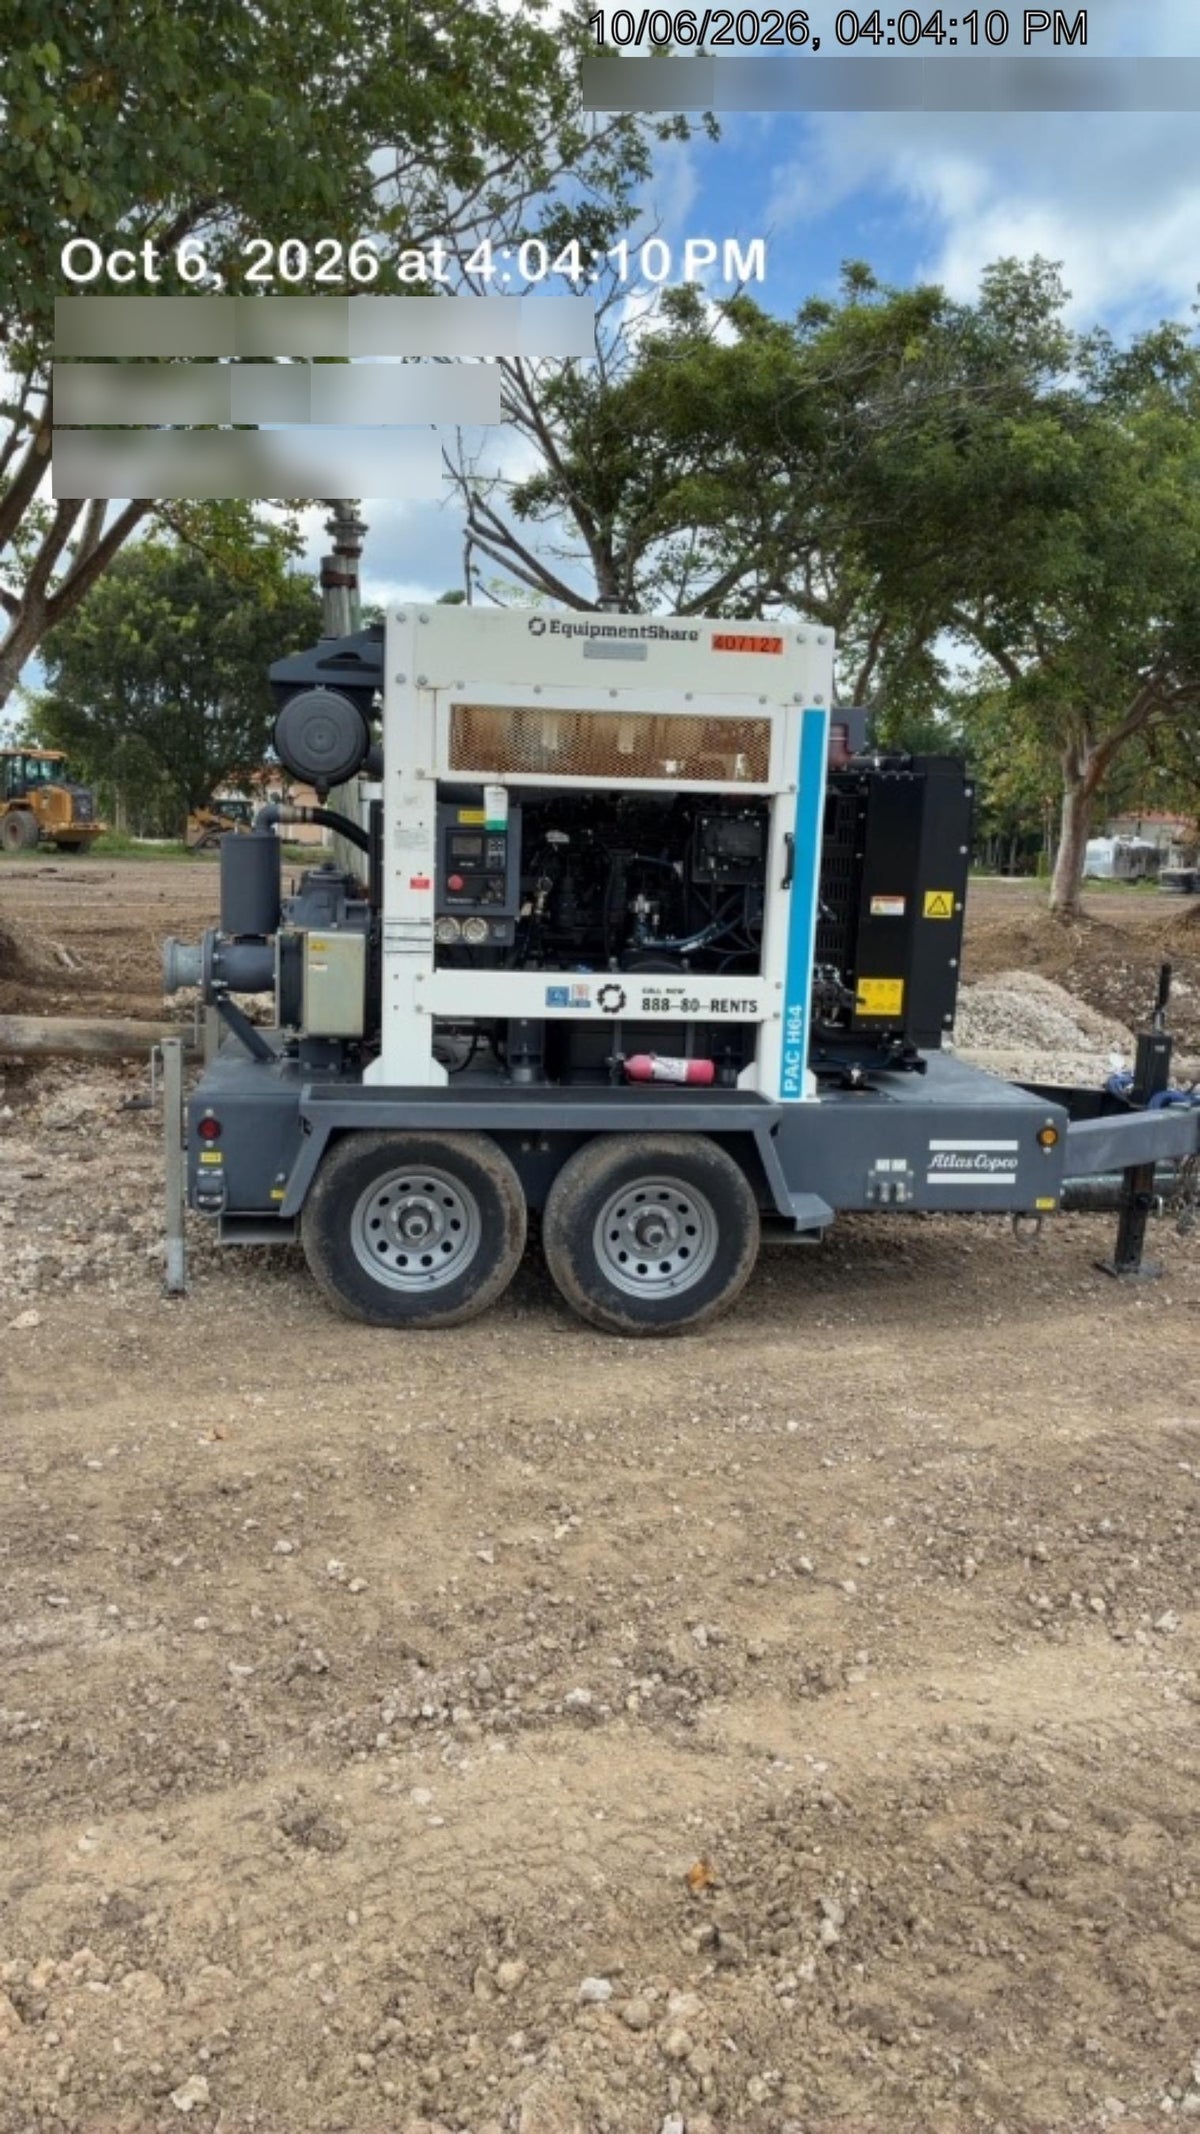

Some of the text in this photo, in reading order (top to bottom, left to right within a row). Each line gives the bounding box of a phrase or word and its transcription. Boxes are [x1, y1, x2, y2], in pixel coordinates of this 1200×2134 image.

[549, 619, 699, 641] EquipmentShare
[713, 634, 783, 655] 407127
[783, 1004, 803, 1092] PAC H64
